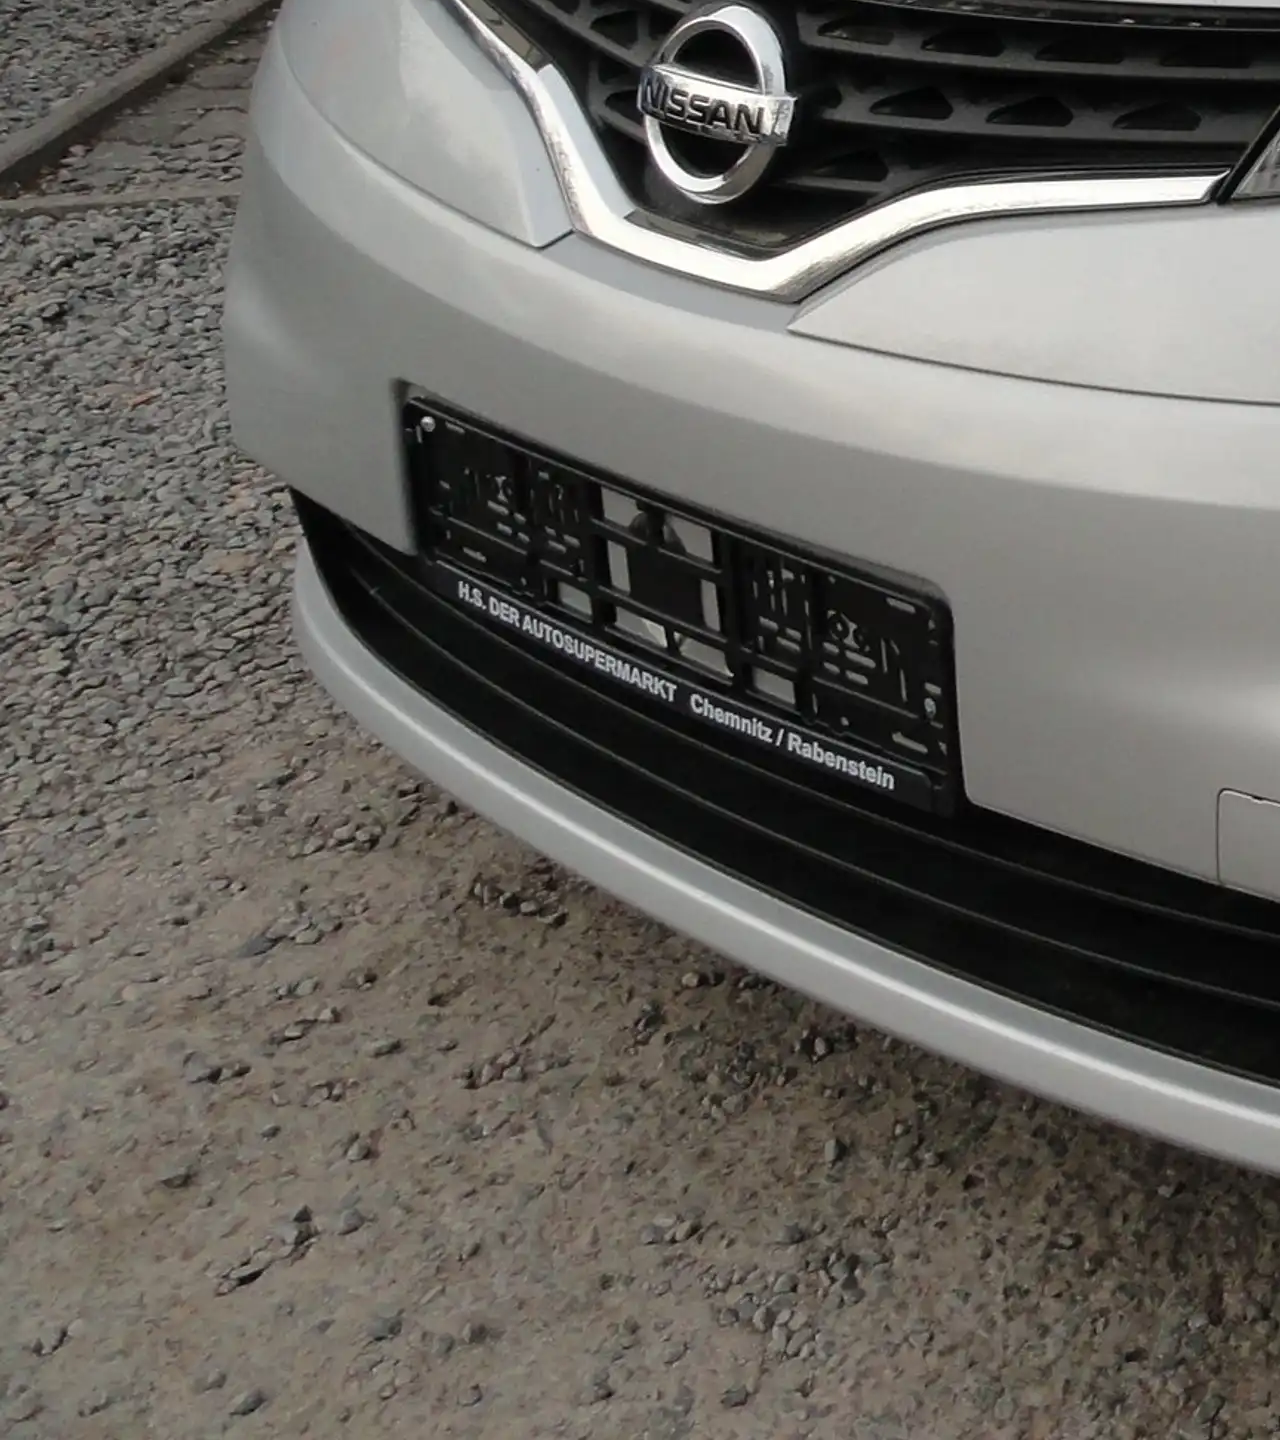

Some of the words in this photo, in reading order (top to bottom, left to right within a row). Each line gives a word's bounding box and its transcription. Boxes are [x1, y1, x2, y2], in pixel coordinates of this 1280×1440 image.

[643, 76, 766, 136] NISSAN
[457, 580, 488, 610] H.S.
[489, 595, 521, 628] DER
[522, 614, 678, 703] AUTOSUPERMARKT
[690, 692, 774, 744] Chemnitz
[775, 727, 785, 748] /
[786, 731, 895, 791] Rabenstein
